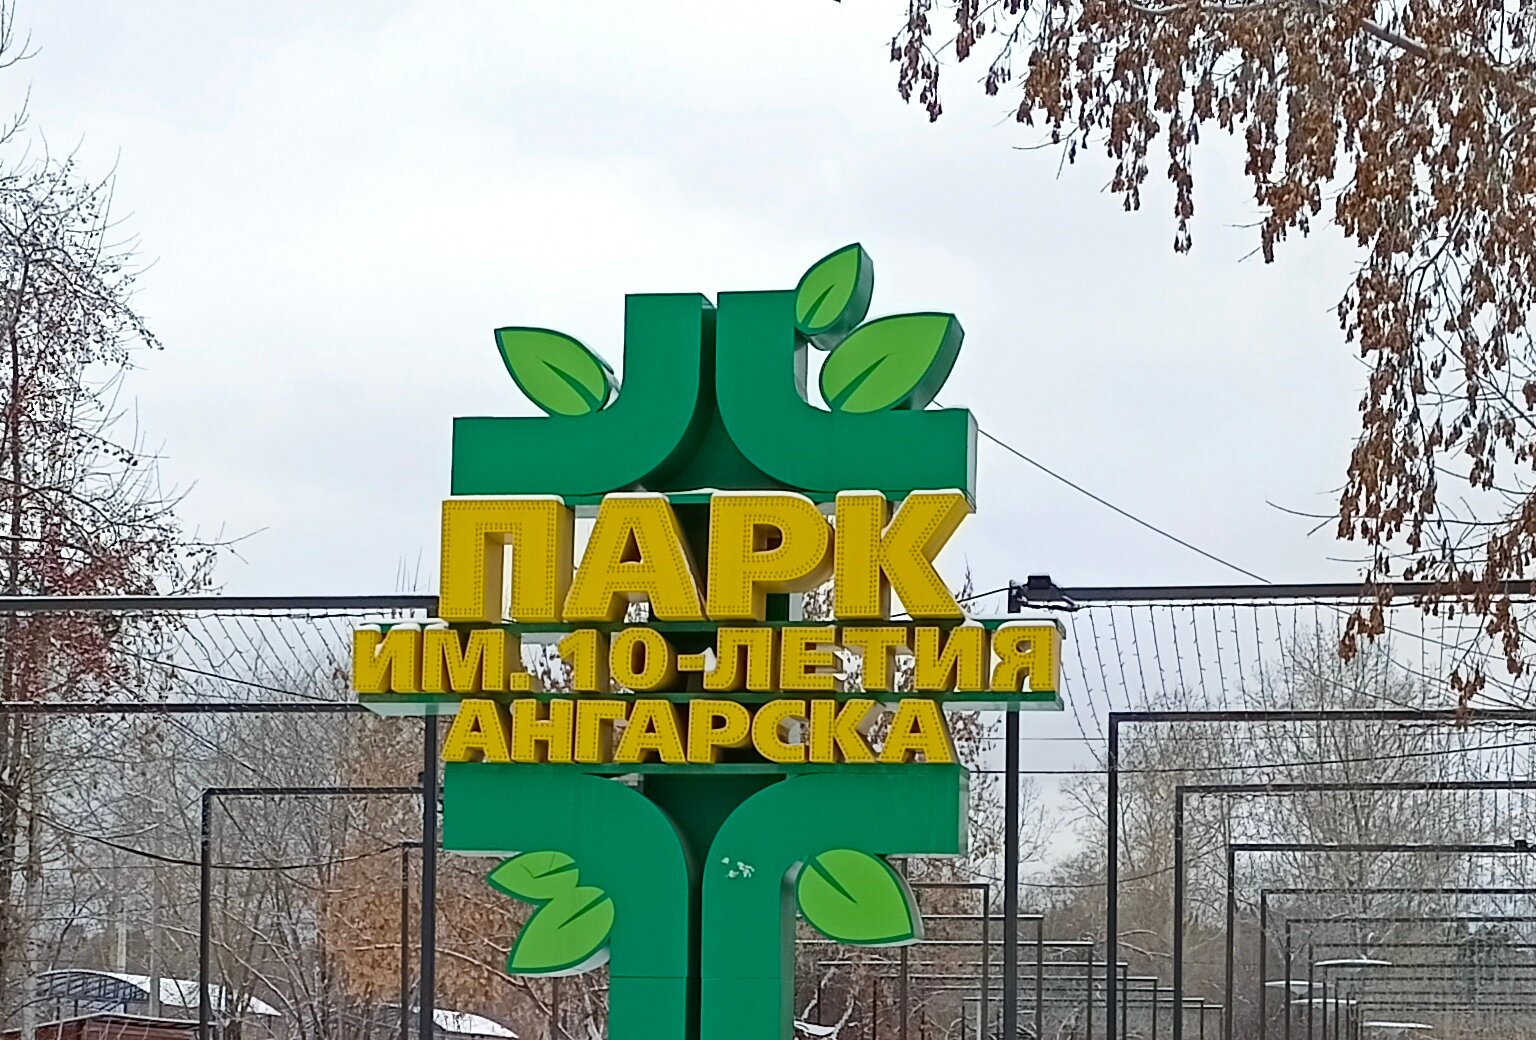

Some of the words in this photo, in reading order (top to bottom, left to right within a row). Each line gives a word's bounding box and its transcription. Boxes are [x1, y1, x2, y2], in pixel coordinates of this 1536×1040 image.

[438, 493, 968, 623] ПАРК
[352, 626, 536, 693] ИМ.
[558, 624, 1060, 693] 10-ЛЕТИЯ
[441, 698, 958, 764] АНГАРСКА
